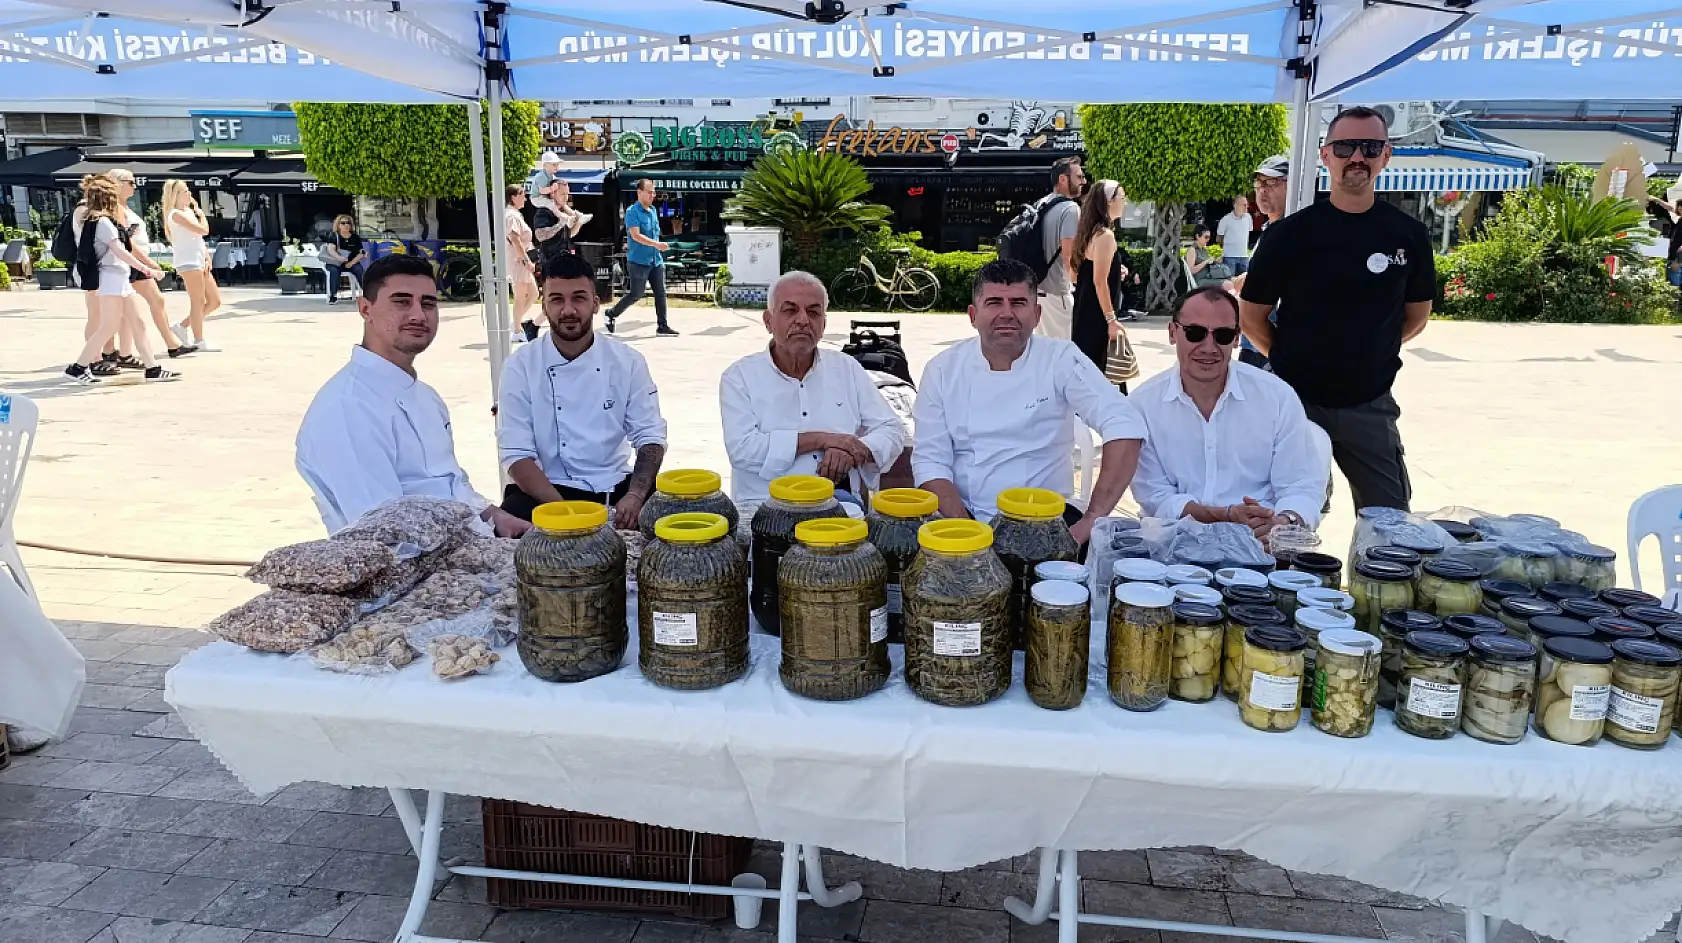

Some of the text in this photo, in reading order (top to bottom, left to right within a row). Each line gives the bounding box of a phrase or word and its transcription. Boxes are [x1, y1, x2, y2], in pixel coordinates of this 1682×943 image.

[200, 118, 242, 143] ŞEF
[541, 120, 572, 138] PUB
[652, 126, 695, 149] BIG
[700, 126, 763, 149] BOSS
[816, 113, 939, 159] frekans
[724, 150, 748, 162] PUB
[666, 179, 688, 189] BEER
[689, 179, 730, 189] COCKTAIL
